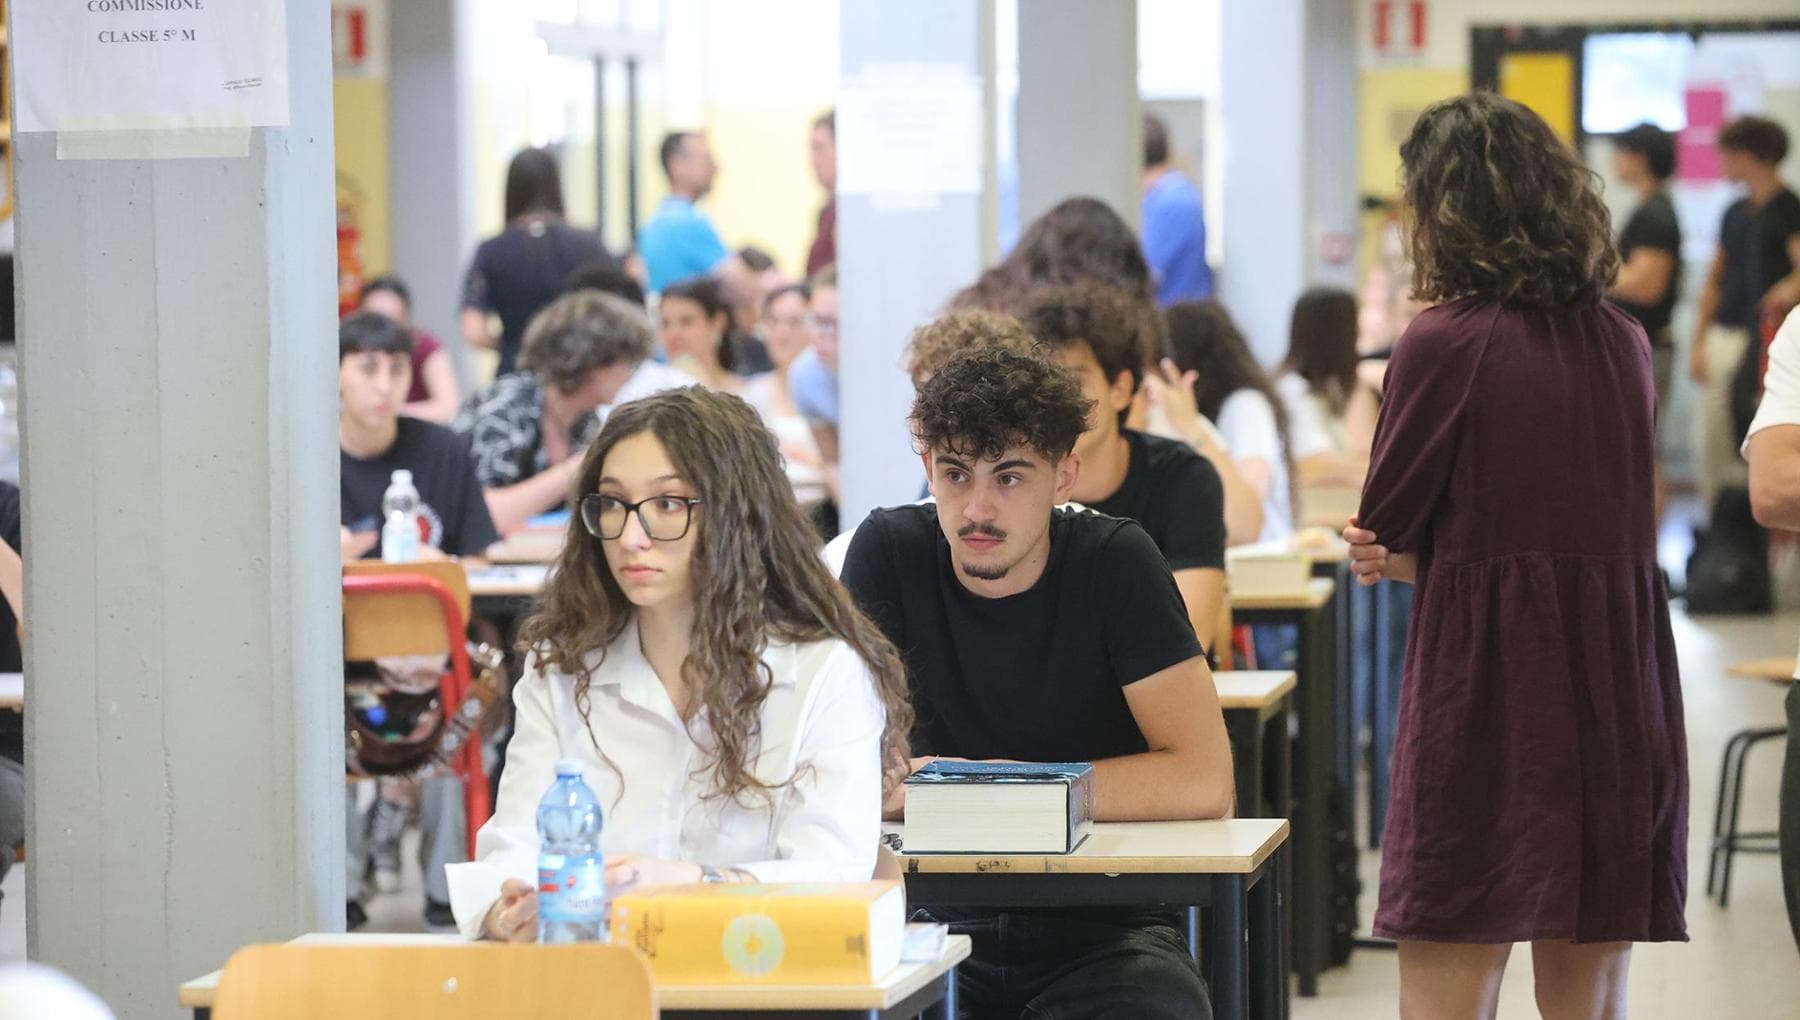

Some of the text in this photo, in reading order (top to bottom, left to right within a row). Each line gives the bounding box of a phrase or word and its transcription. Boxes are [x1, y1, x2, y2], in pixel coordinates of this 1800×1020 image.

[87, 0, 204, 12] COMMISSIONE
[98, 30, 159, 43] CLASSE
[182, 29, 196, 41] M
